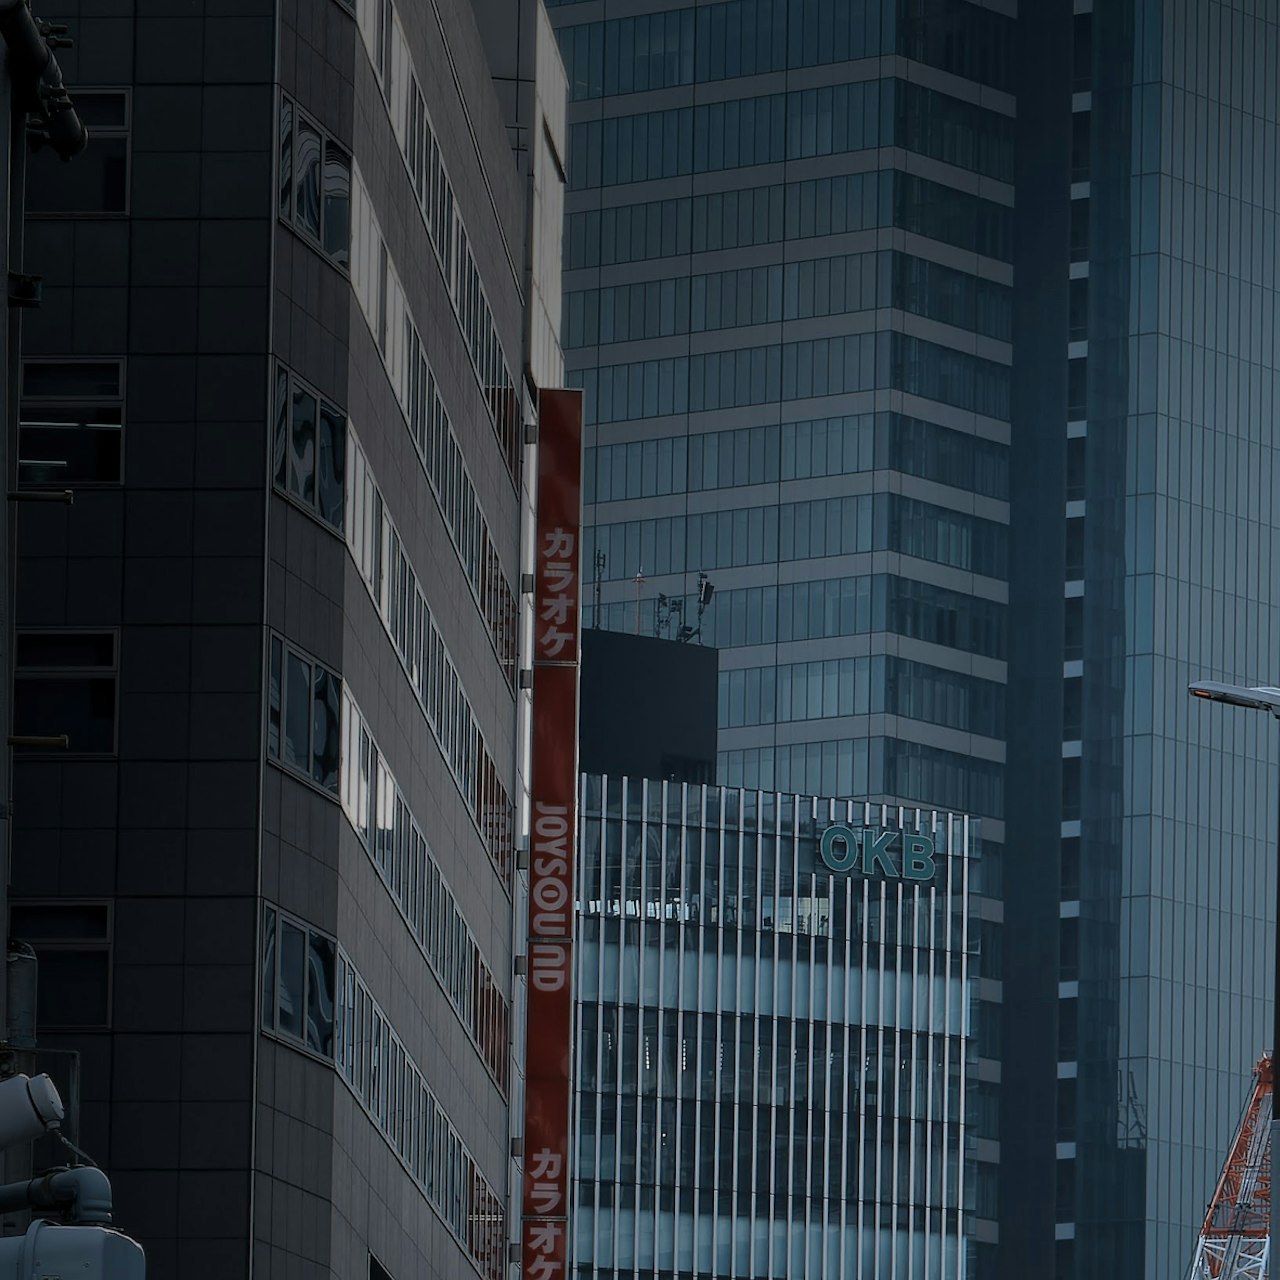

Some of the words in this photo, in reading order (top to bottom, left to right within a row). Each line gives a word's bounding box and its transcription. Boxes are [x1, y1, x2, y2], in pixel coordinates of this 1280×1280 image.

[540, 527, 575, 657] カラオケ
[533, 800, 569, 992] JOYSOUND
[820, 824, 936, 881] OKB
